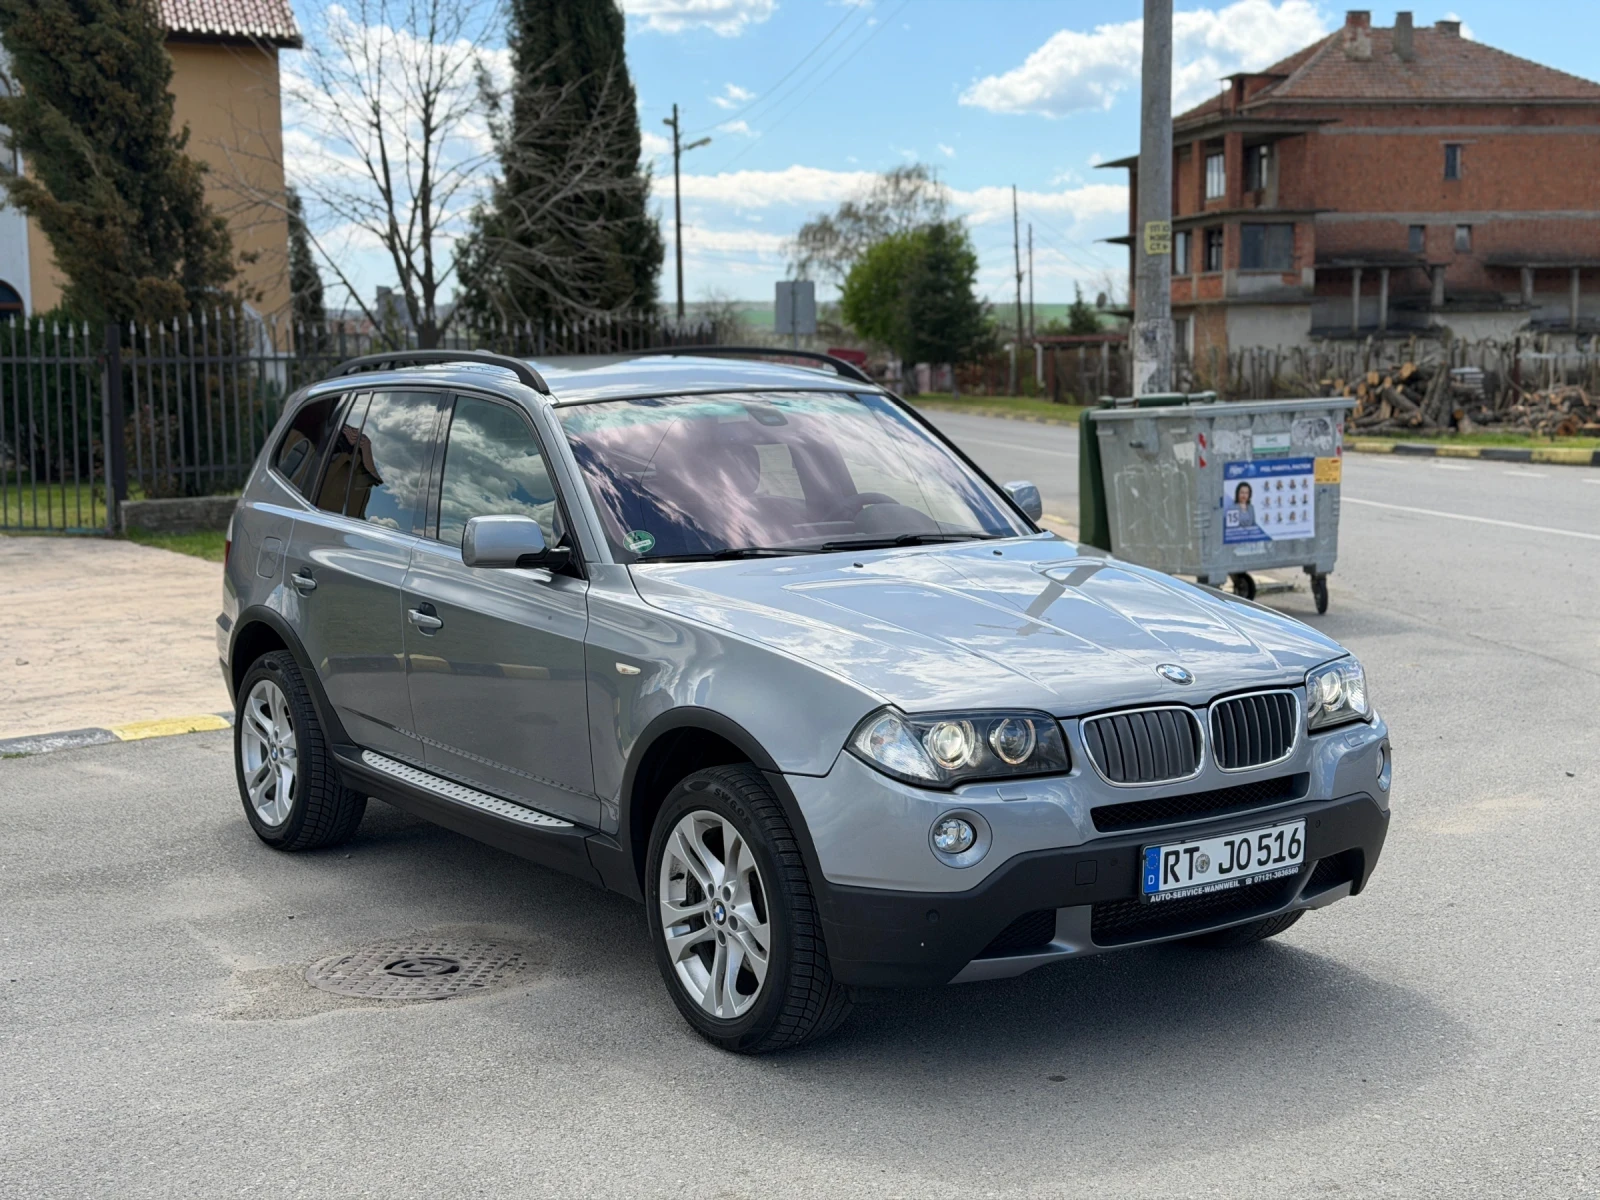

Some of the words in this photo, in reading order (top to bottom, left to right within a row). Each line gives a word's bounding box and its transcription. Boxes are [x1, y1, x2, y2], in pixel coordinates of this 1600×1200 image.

[1228, 512, 1238, 523] 15
[1148, 874, 1155, 885] D
[1163, 846, 1200, 885] RT
[1218, 837, 1252, 875] JO
[1257, 827, 1302, 867] 516
[1150, 880, 1240, 903] AUTO-SERVICE-WANNWEIL
